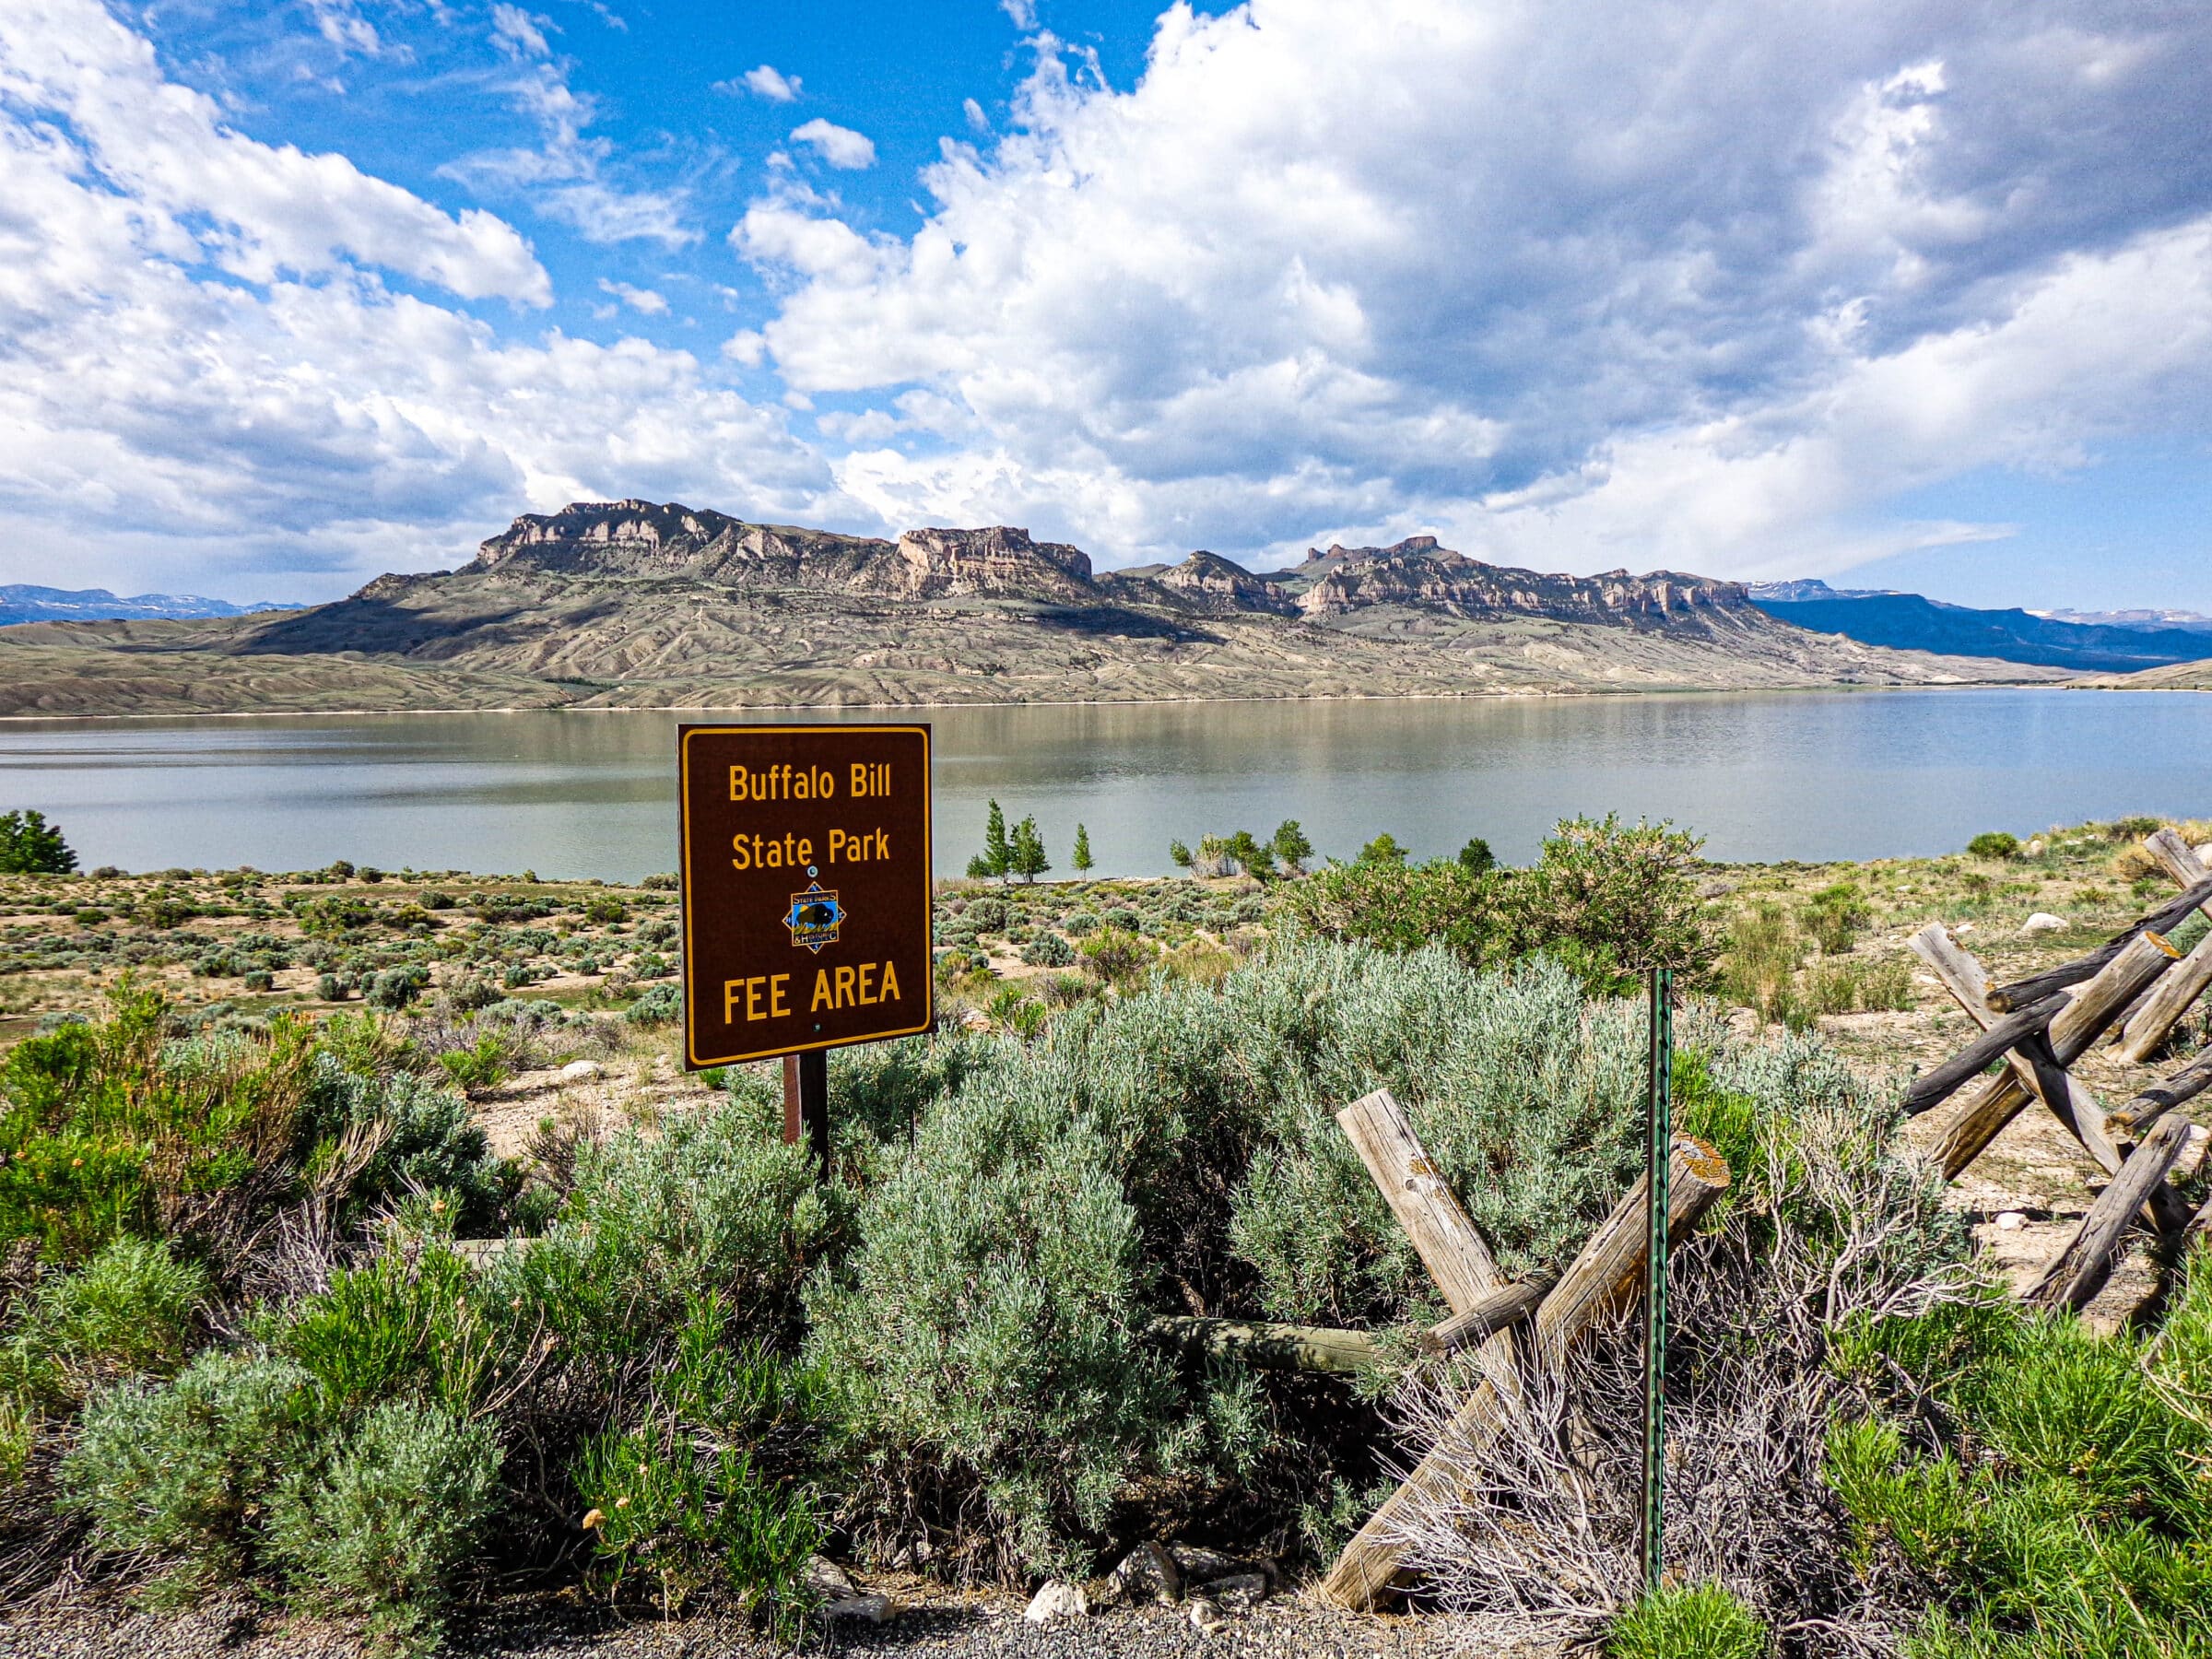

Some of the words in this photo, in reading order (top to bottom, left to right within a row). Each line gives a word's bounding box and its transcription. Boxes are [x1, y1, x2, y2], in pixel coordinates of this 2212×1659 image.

[730, 764, 834, 801] Buffalo
[851, 763, 891, 797] Bill
[732, 832, 812, 869] State
[830, 827, 889, 864] Park
[724, 973, 791, 1024] FEE
[811, 961, 900, 1012] AREA
